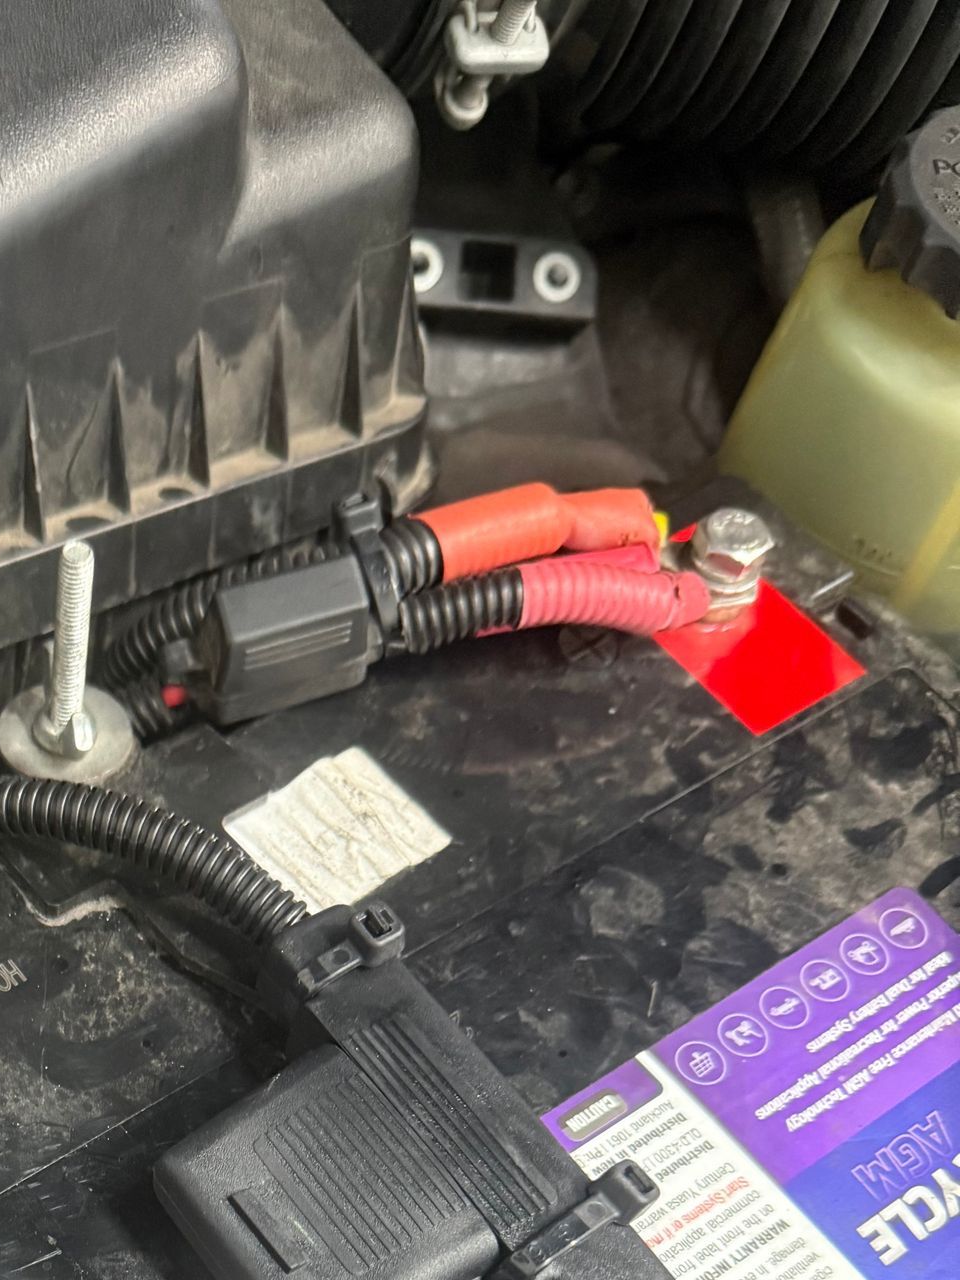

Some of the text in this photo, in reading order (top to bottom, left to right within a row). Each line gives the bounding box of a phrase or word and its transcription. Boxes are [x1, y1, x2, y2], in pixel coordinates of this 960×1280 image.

[885, 979, 913, 1001] Dual
[849, 994, 889, 1024] Battery
[806, 1018, 853, 1054] Systems
[756, 997, 930, 1120] Power Recreational Applications
[786, 1011, 956, 1131] Maintenance Free AGM Technology
[564, 1093, 618, 1131] CAUTION
[630, 1100, 674, 1132] Auckland
[606, 1129, 632, 1148] 1061
[628, 1113, 687, 1153] Distributed
[655, 1140, 714, 1182] Distributed
[852, 1111, 950, 1196] AGM
[695, 1162, 735, 1190] Century
[722, 1176, 749, 1197] Start
[665, 1188, 700, 1210] Yuasa
[682, 1192, 725, 1223] Systems
[705, 1190, 760, 1232] commercial
[859, 1157, 960, 1263] YCLE
[694, 1242, 721, 1264] label
[717, 1226, 745, 1247] front
[730, 1220, 789, 1264] WARRANTY
